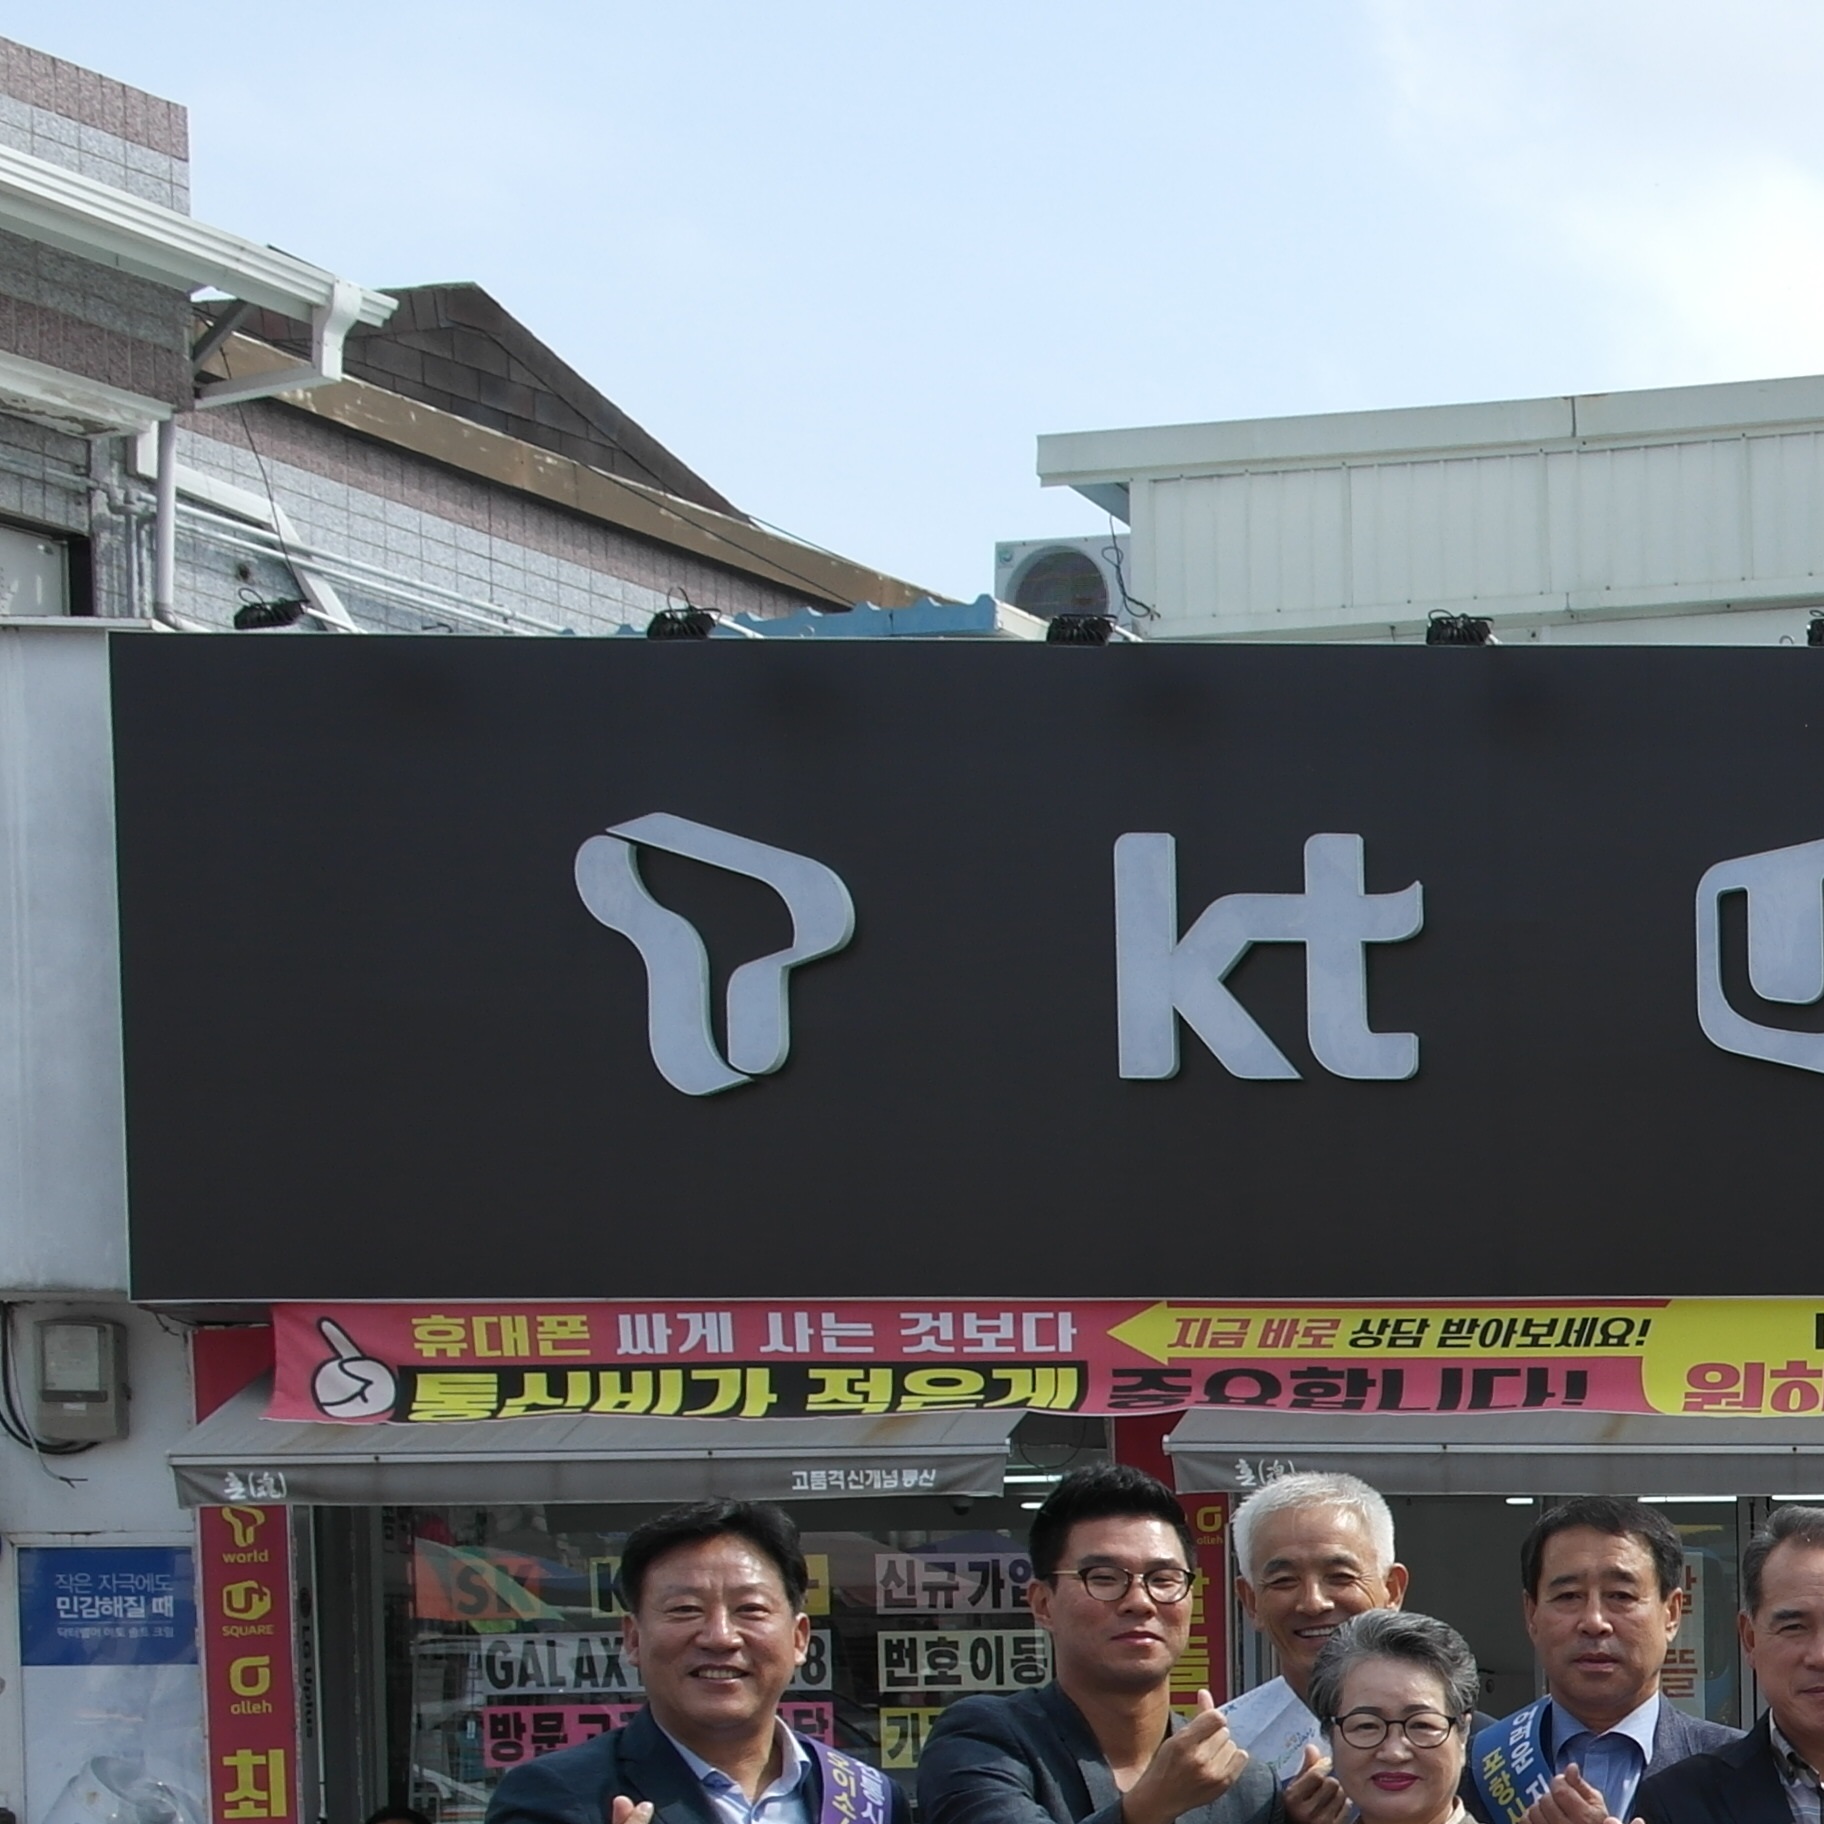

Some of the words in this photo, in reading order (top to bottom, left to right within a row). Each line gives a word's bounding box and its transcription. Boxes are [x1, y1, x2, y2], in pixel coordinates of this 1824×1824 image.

[1113, 833, 1423, 1080] kt
[411, 1313, 591, 1360] 휴대폰
[616, 1312, 735, 1355] 싸게
[759, 1311, 875, 1354] 사는
[899, 1311, 1077, 1354] 것보다
[1167, 1317, 1248, 1349] 지금
[1256, 1317, 1341, 1349] 바로
[1349, 1317, 1432, 1348] 상담
[1437, 1317, 1653, 1348] 받아보세요!
[405, 1367, 778, 1421] 통신비가
[1107, 1366, 1588, 1411] 중요합니다!
[222, 1549, 269, 1563] world
[55, 1573, 92, 1593] 작은
[98, 1573, 174, 1593] 자극에도
[56, 1596, 146, 1618] 민감해질
[152, 1596, 174, 1617] 때
[221, 1624, 274, 1636] SQUARE
[485, 1639, 641, 1690] GALAX
[884, 1636, 1050, 1688] 번호이동
[229, 1699, 273, 1715] olleh
